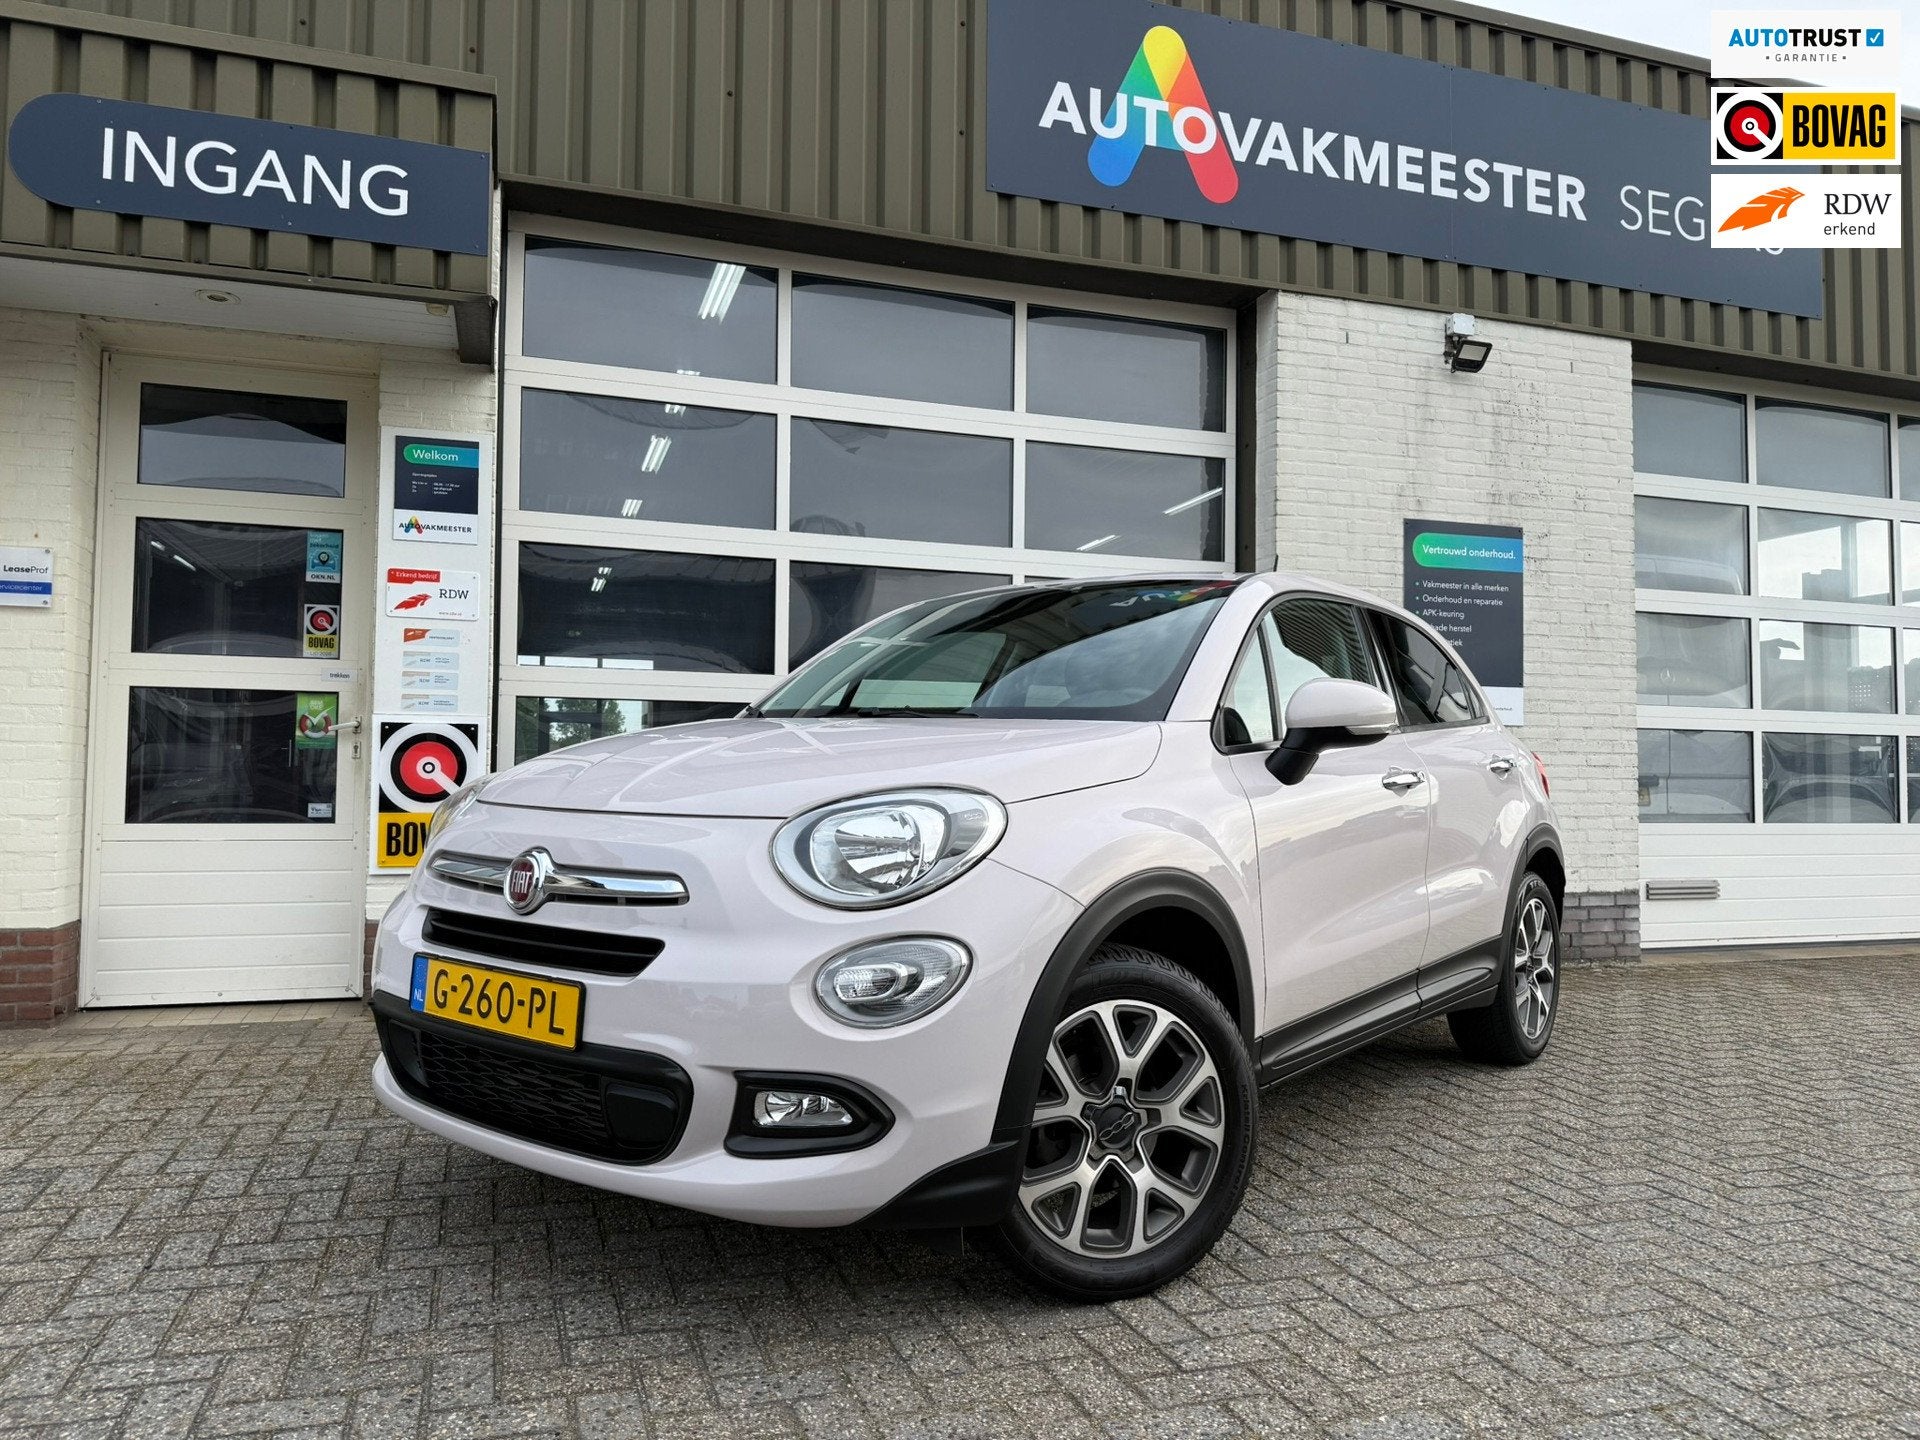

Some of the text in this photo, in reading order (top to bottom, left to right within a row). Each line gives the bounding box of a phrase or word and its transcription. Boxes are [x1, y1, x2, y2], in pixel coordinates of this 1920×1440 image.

[1038, 80, 1587, 221] AUTOVAKMEESTER
[102, 127, 409, 217] INGANG
[412, 449, 459, 462] Welkom
[398, 522, 472, 533] AUTOVAKMEESTER
[1422, 544, 1516, 560] Vertrouwd onderhoud.
[3, 564, 49, 574] LeaseProf
[1422, 580, 1509, 592] Vakmeester in alle merken
[439, 588, 469, 600] RDW
[1422, 594, 1463, 604] Onderhoud
[1473, 598, 1503, 607] reparatie
[1422, 608, 1465, 620] APK-keuring
[1448, 623, 1472, 633] herstel
[308, 636, 335, 649] BOVAG
[510, 870, 533, 894] FIAT
[413, 988, 424, 1002] NL
[434, 968, 565, 1035] G-260-PL
